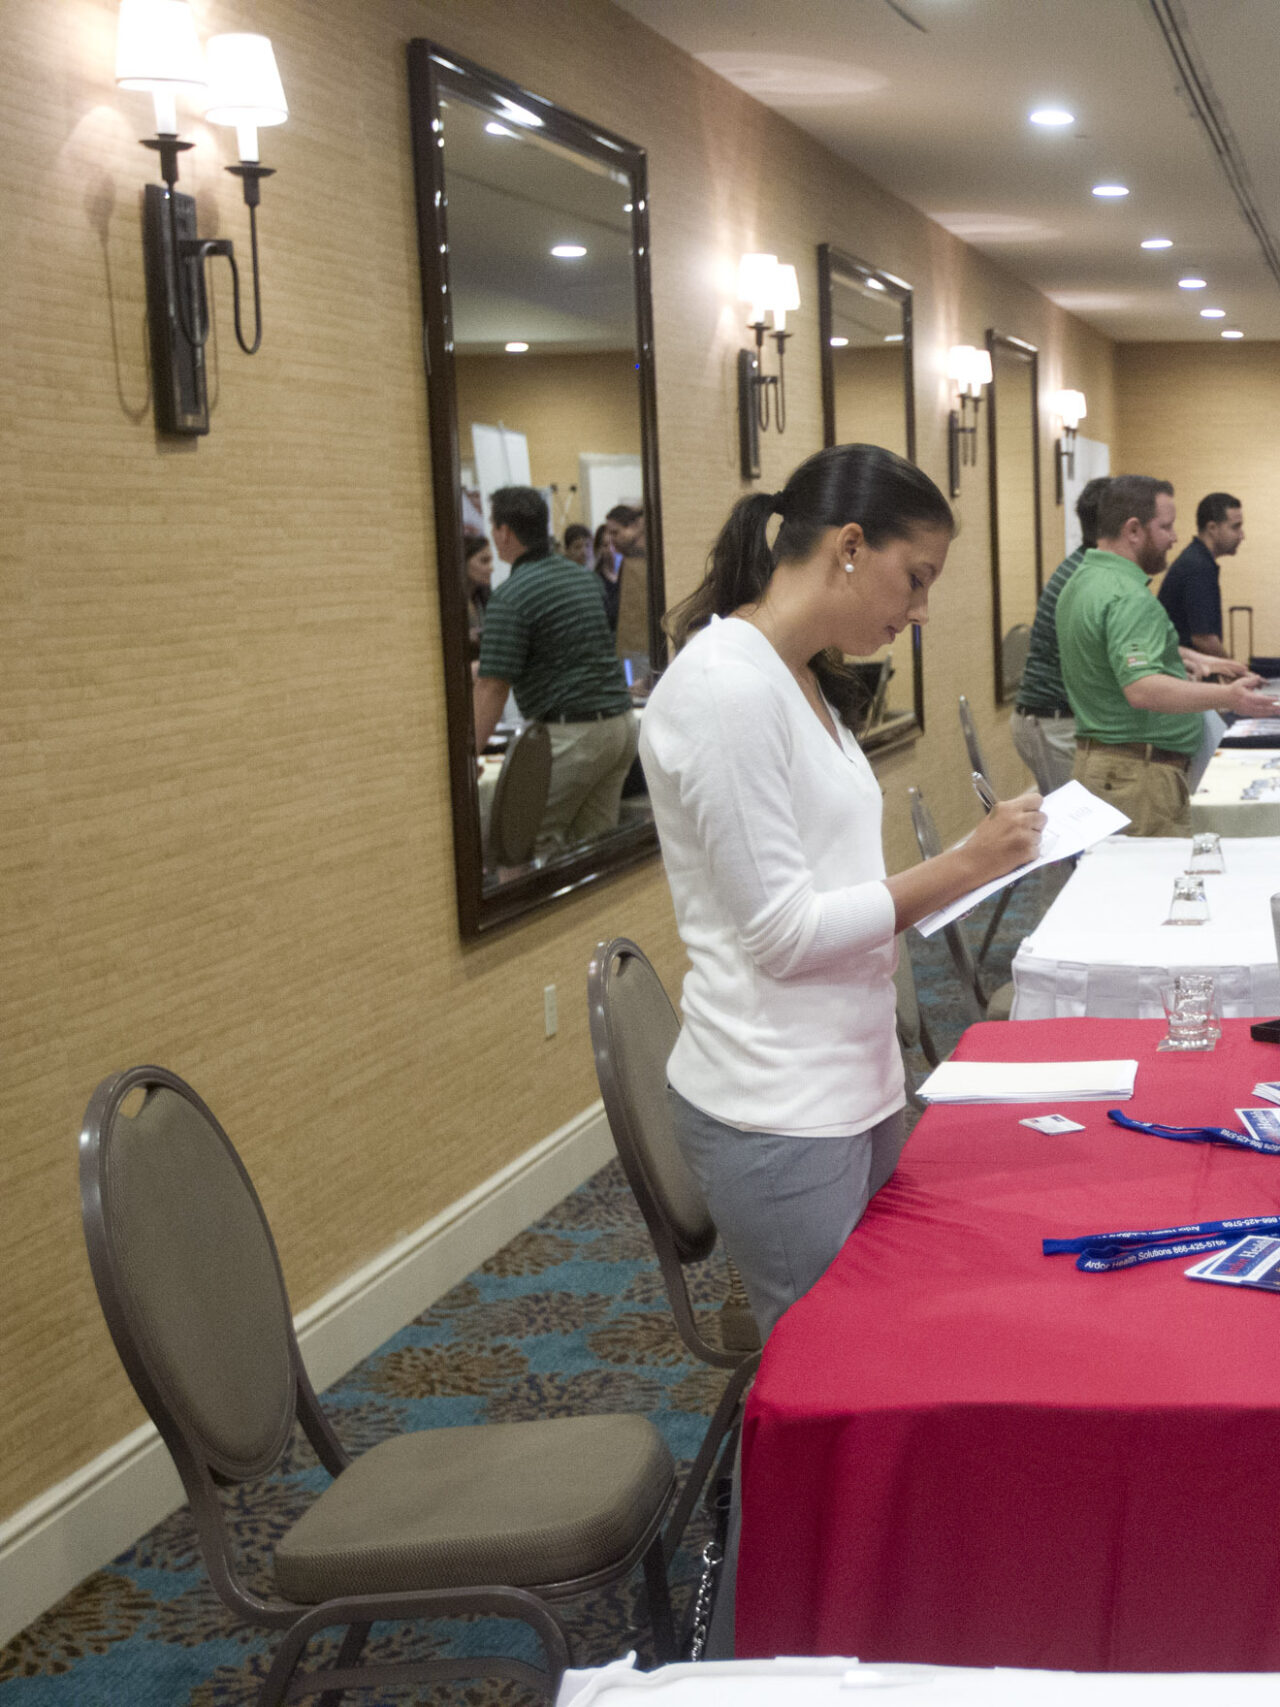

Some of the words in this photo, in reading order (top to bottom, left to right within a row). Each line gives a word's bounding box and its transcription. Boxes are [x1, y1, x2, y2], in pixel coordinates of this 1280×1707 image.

[1084, 1259, 1112, 1269] Ardor
[1112, 1255, 1136, 1268] Health
[1138, 1247, 1173, 1261] Solutions
[1239, 1238, 1275, 1258] Health
